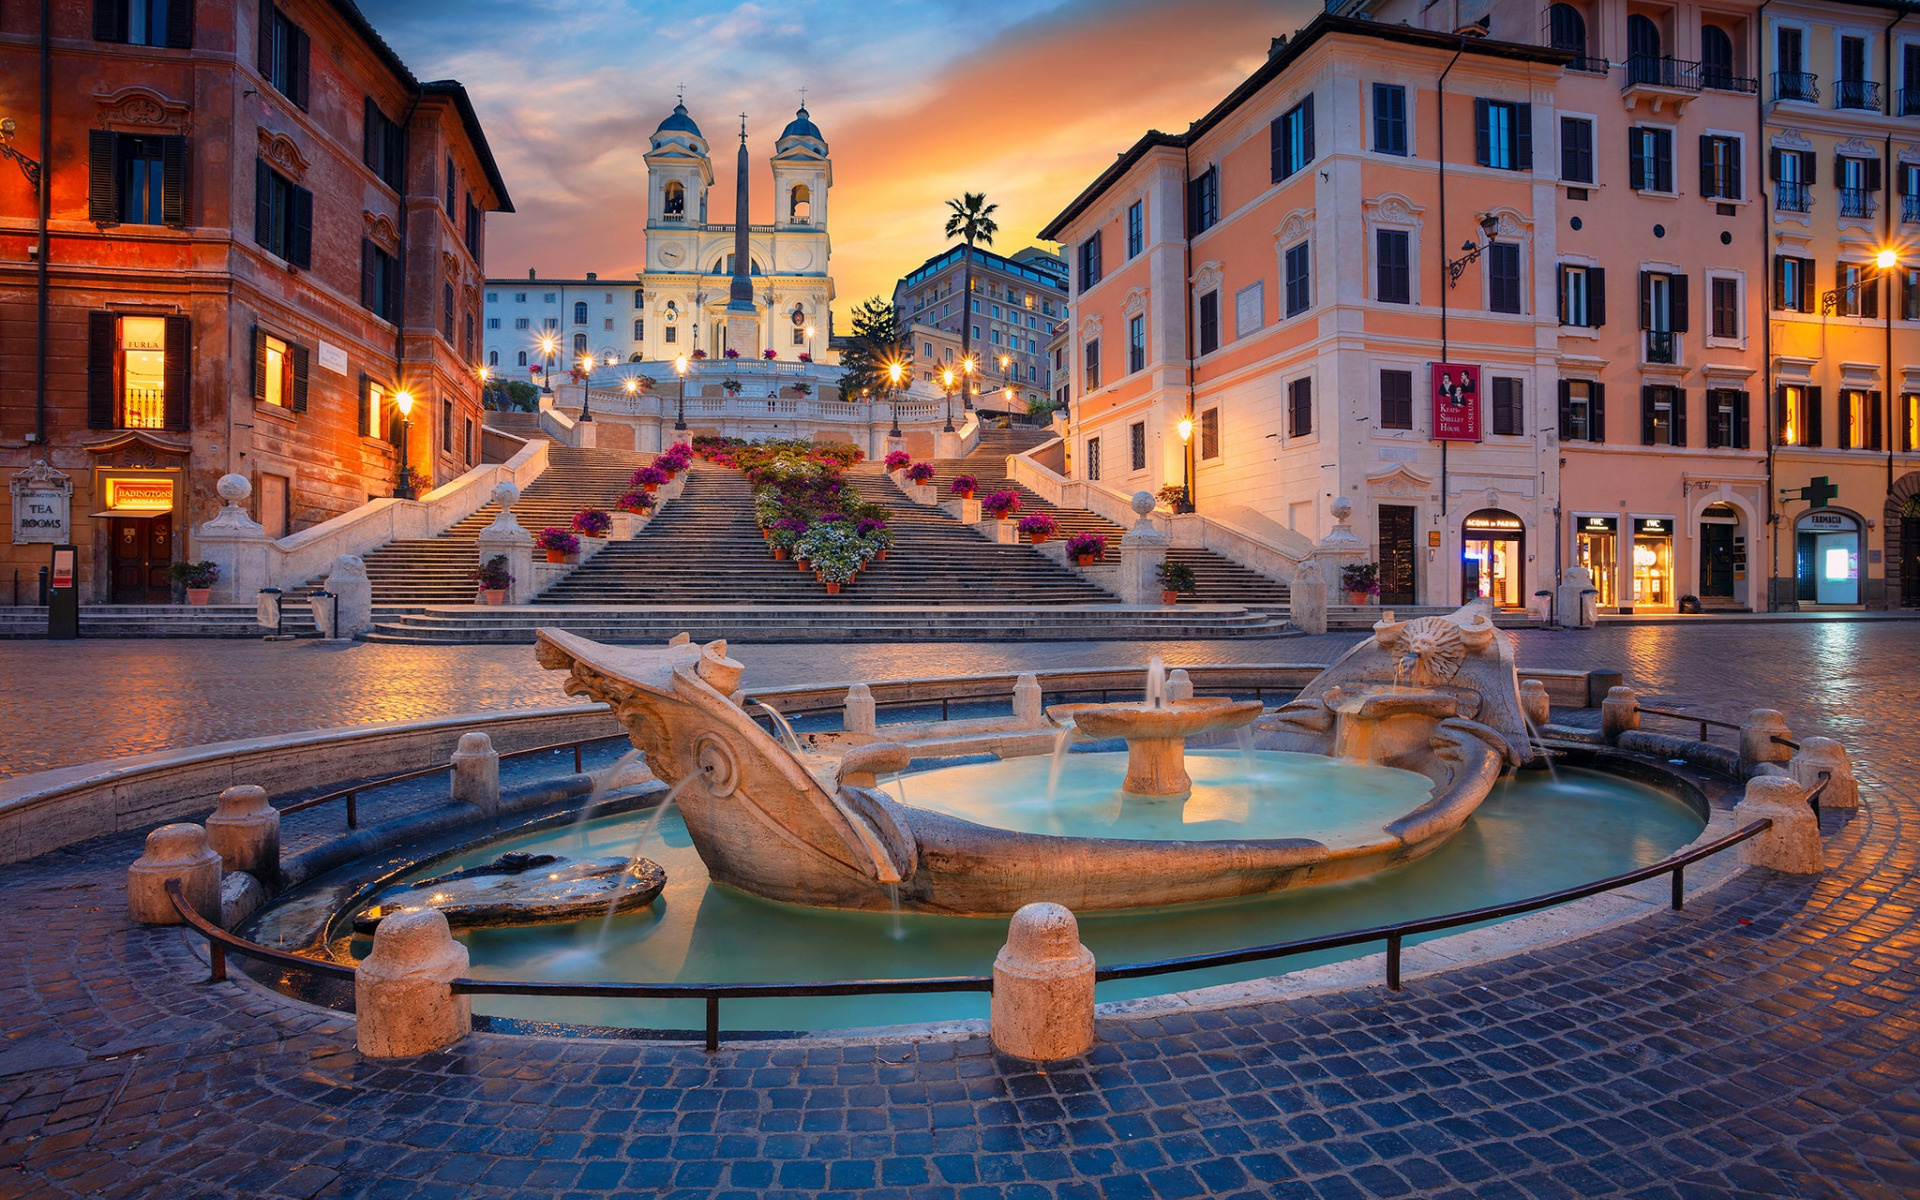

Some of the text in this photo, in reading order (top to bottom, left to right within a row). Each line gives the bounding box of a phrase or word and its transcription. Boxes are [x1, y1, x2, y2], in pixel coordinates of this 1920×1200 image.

[29, 504, 54, 514] TEA
[22, 519, 61, 528] ROOMS
[1466, 519, 1490, 527] ACQUA
[1496, 520, 1520, 528] PARMA
[1590, 518, 1604, 526] IWC
[1646, 519, 1660, 527] IWC
